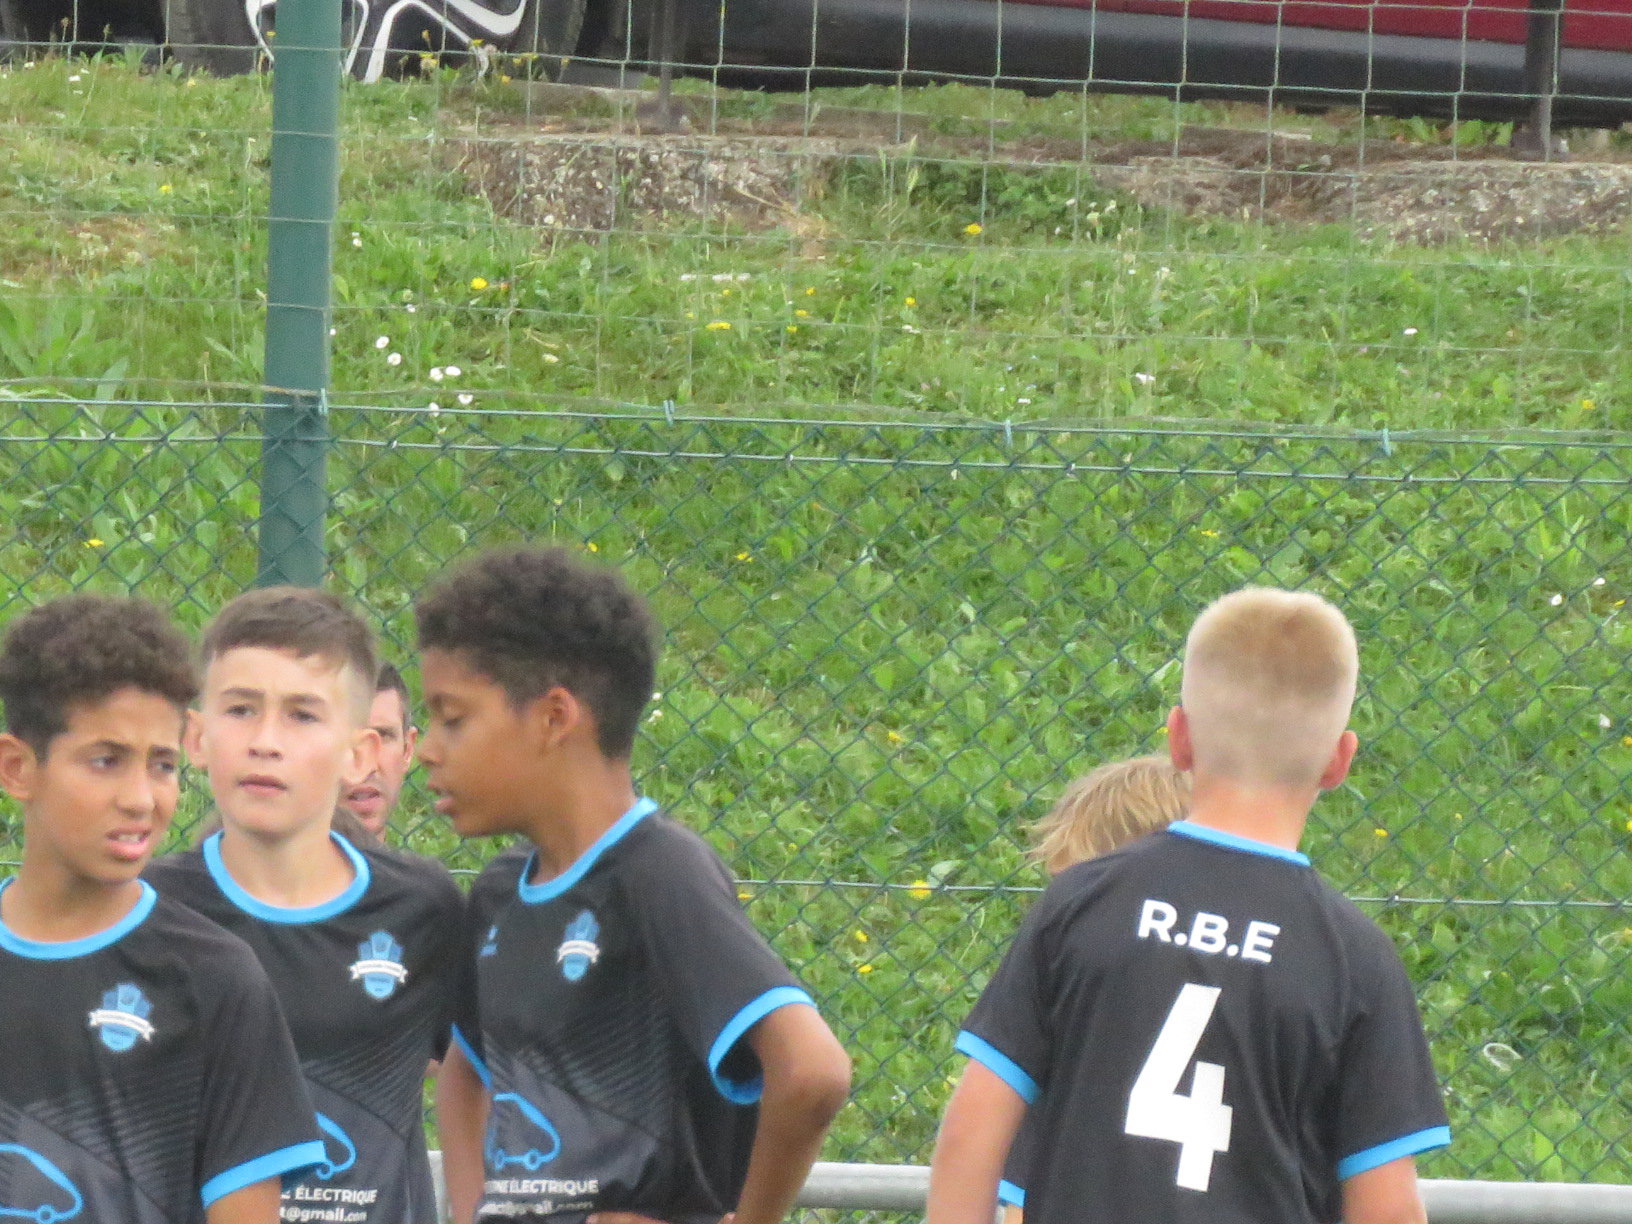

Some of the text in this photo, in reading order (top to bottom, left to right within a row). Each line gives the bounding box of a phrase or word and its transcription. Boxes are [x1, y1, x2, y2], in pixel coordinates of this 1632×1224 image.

[1137, 898, 1281, 964] R.B.E
[1124, 982, 1234, 1193] 4
[294, 1184, 378, 1205] ÉLECTRIQUE
